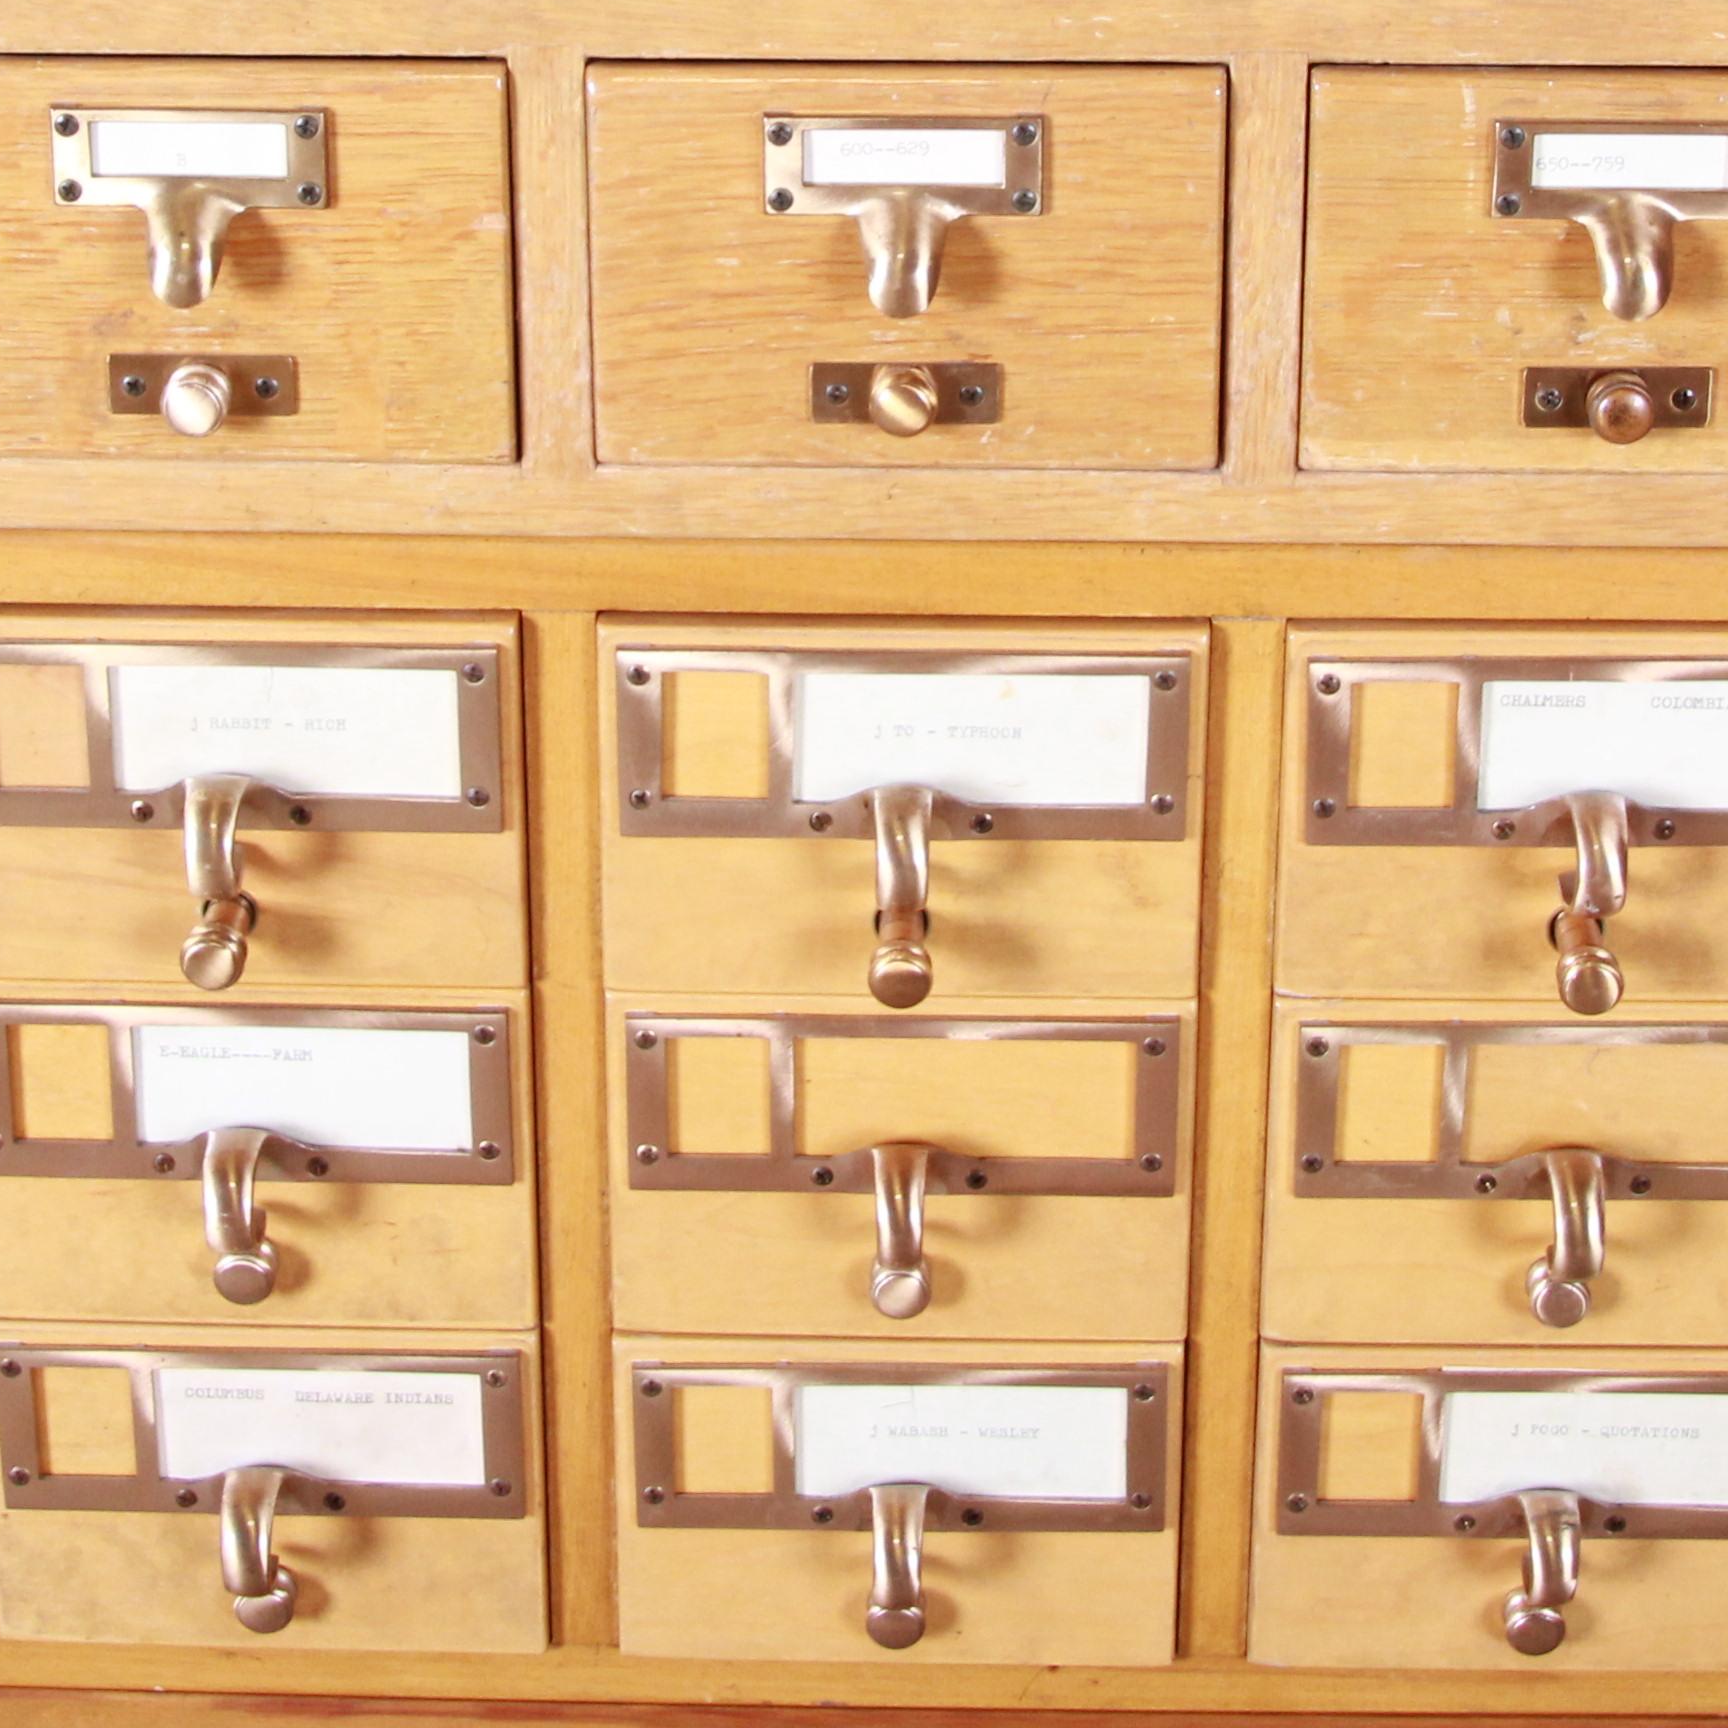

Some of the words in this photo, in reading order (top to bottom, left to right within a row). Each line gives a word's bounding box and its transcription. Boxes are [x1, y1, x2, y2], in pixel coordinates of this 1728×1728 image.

[840, 140, 930, 157] 600--629
[1535, 156, 1624, 171] 650--759
[1499, 694, 1587, 710] CHALMERS
[209, 716, 273, 731] RABBIT
[305, 717, 347, 732] RICH
[893, 725, 915, 739] TO
[948, 725, 1023, 740] TYPHOON
[184, 1386, 265, 1401] COLUMBUS
[294, 1390, 374, 1405] DELAWARE
[384, 1391, 454, 1406] INDIANS
[888, 1426, 949, 1438] WABASH
[978, 1426, 1039, 1440] WESLEY
[1531, 1423, 1569, 1437] POGO
[1600, 1424, 1701, 1441] QUOTATIONS
